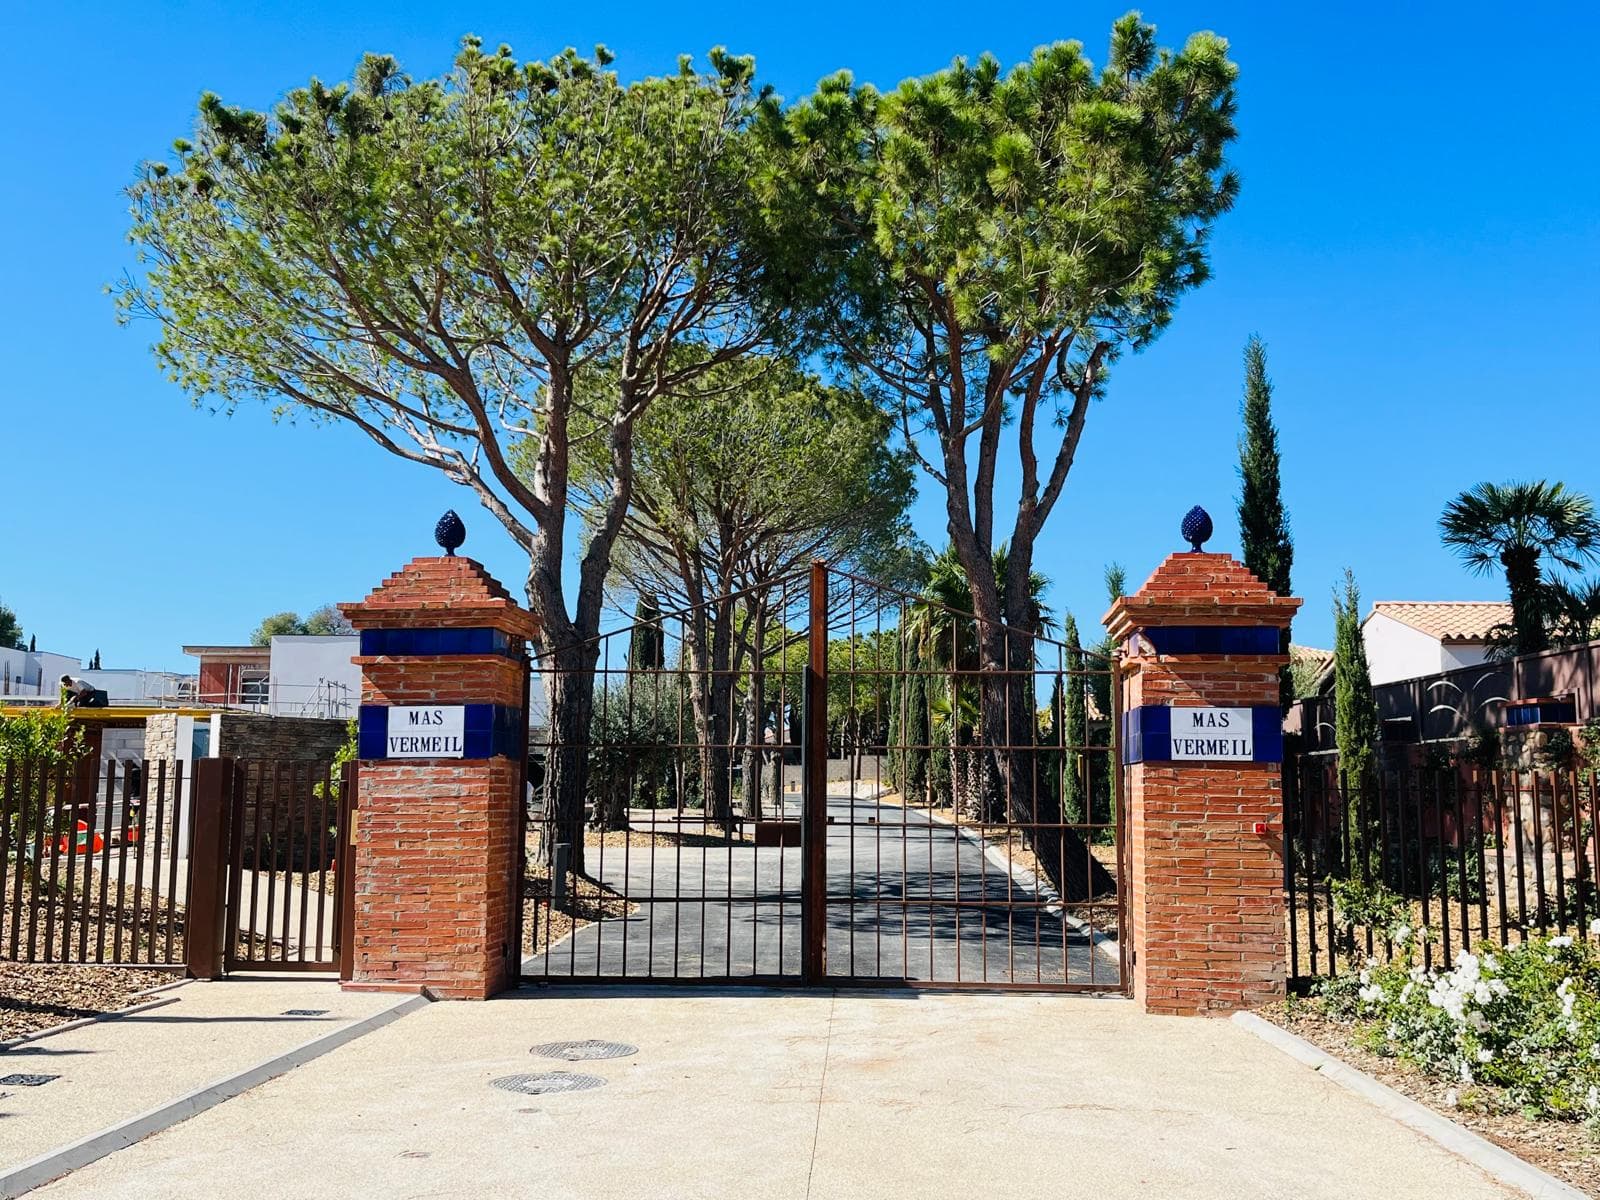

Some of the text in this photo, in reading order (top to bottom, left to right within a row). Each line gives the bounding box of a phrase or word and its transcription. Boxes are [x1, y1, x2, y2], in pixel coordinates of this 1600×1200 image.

[409, 710, 443, 725] MAS
[1192, 711, 1230, 727] MAS
[390, 736, 463, 752] VERMEIL
[1173, 739, 1252, 756] VERMEIL
